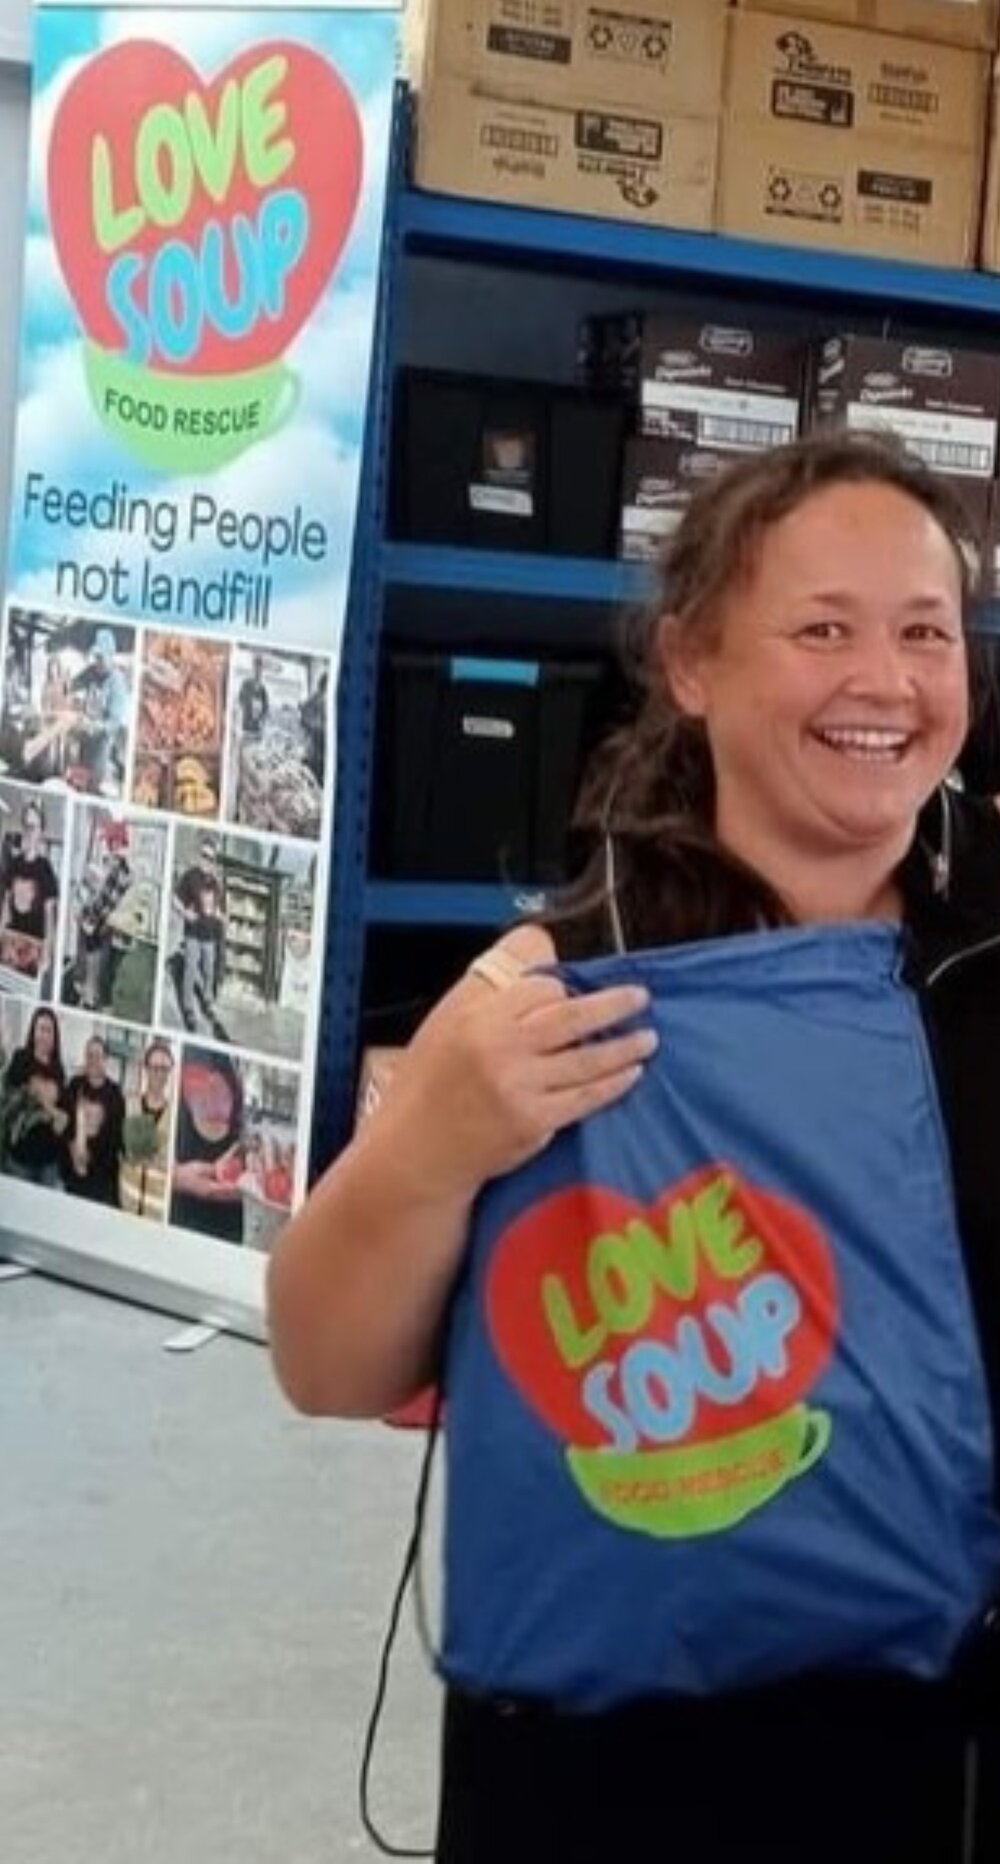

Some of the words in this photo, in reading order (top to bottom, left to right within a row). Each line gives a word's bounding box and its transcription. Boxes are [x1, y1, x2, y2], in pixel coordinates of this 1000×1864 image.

[91, 53, 296, 252] LOVE
[106, 188, 308, 366] SOUP
[105, 388, 168, 431] FOOD
[173, 400, 260, 435] RESCUE
[24, 472, 177, 552] Feeding
[189, 492, 327, 566] People
[56, 557, 130, 607] not
[141, 557, 272, 630] landfill
[541, 1171, 763, 1368] LOVE
[582, 1271, 801, 1456] SOUP
